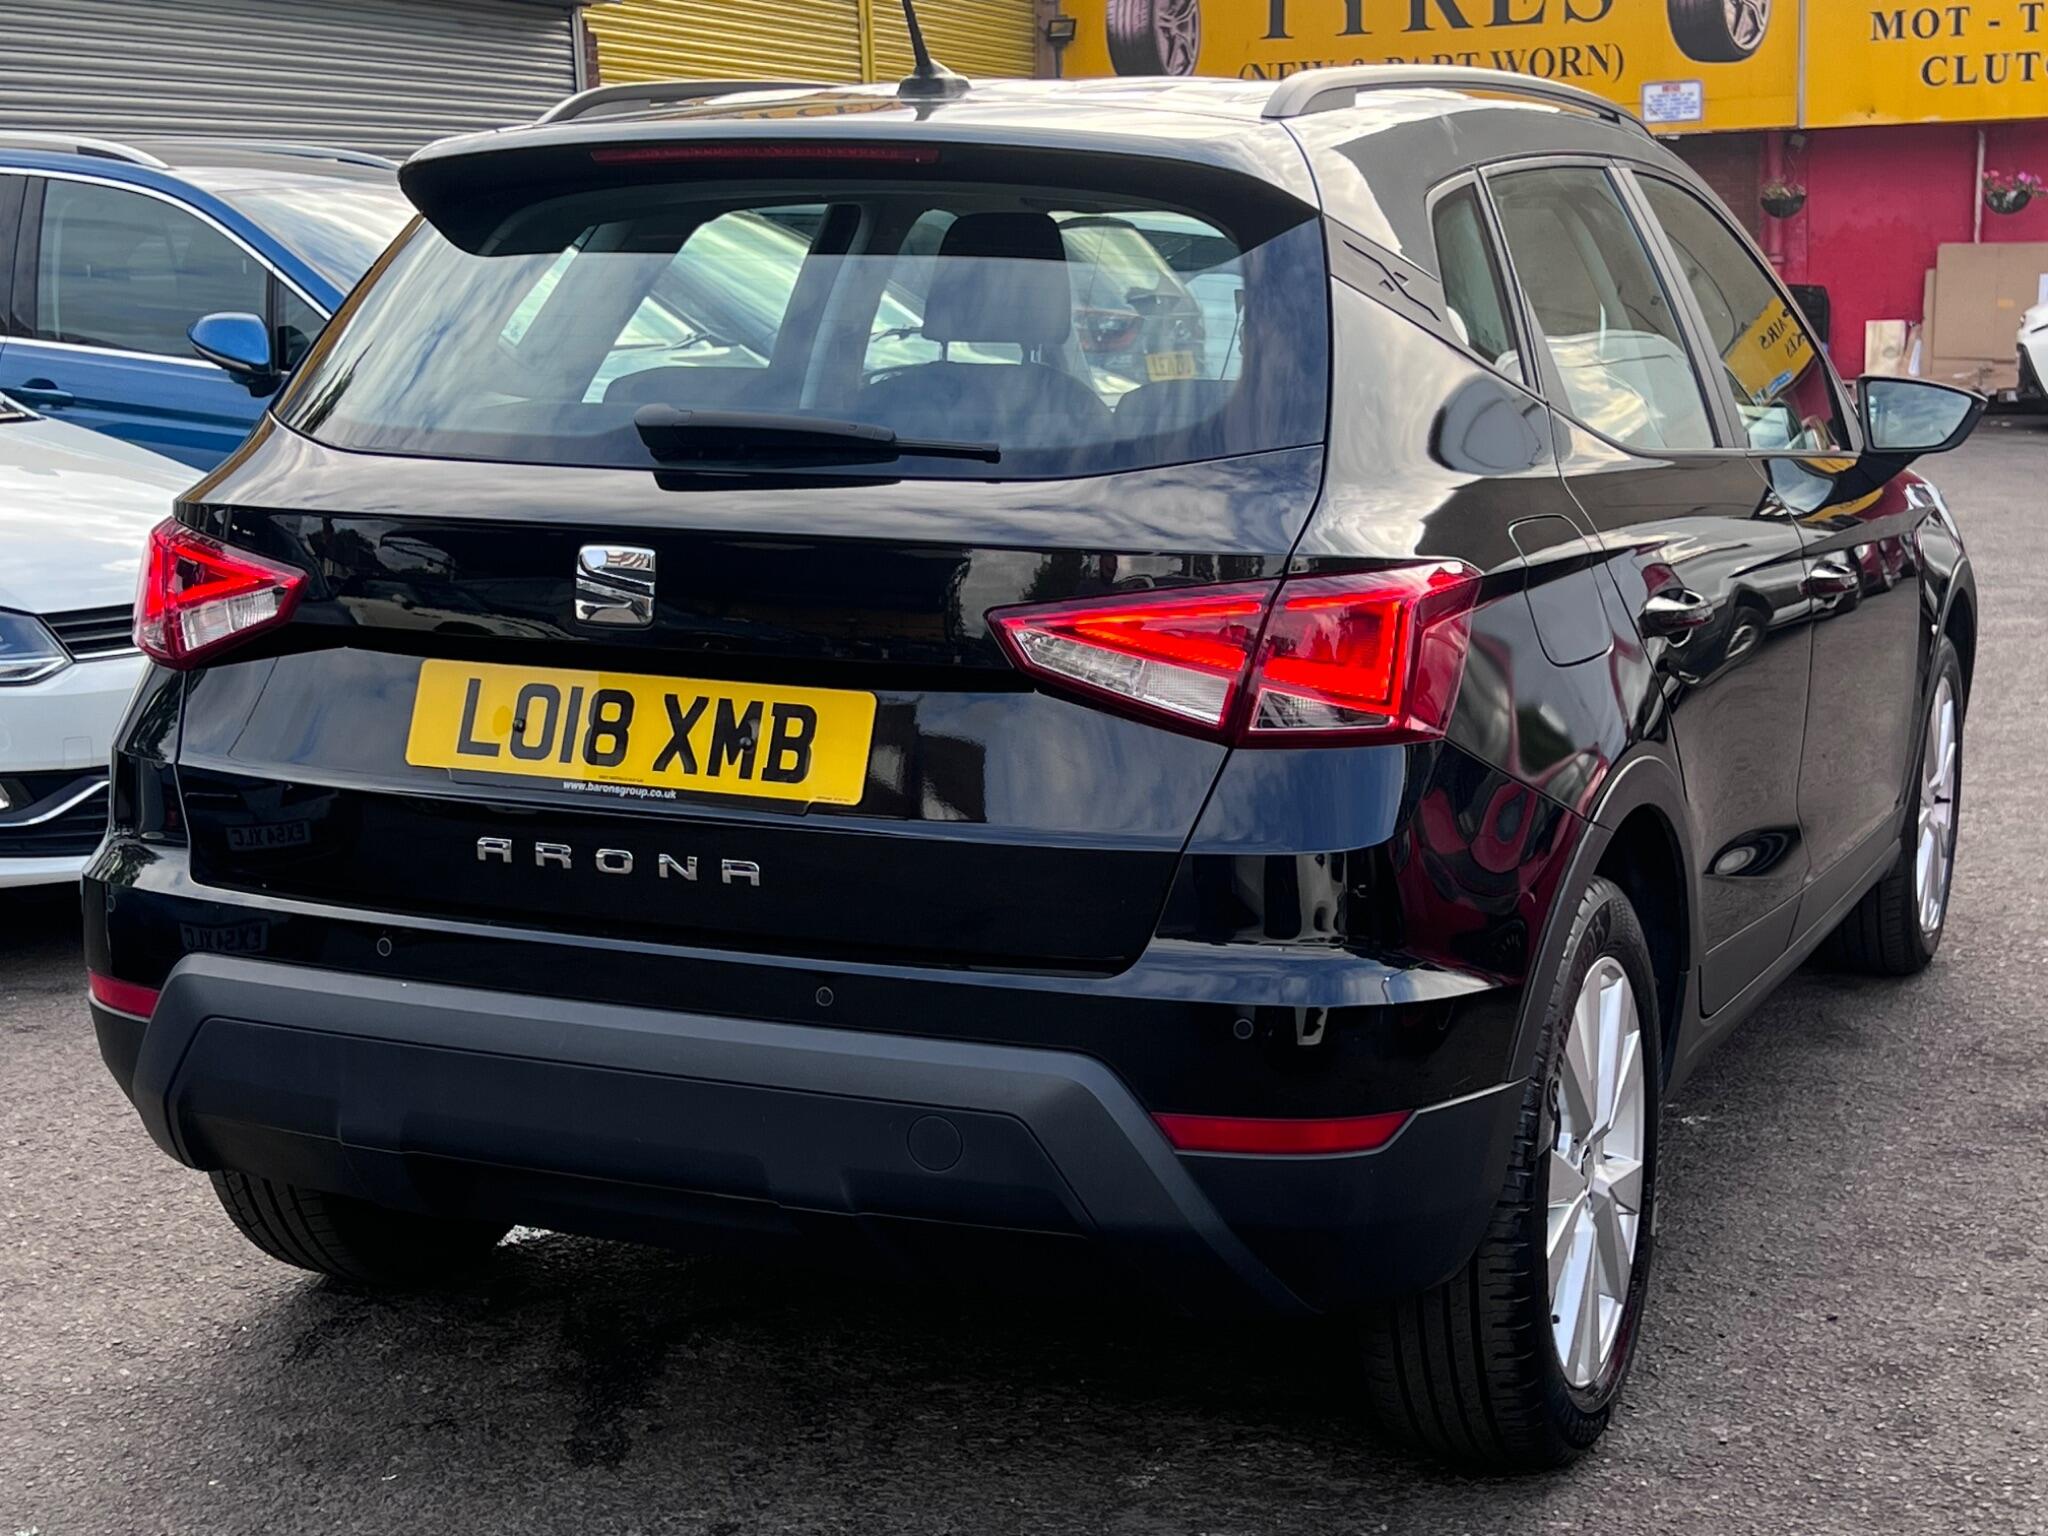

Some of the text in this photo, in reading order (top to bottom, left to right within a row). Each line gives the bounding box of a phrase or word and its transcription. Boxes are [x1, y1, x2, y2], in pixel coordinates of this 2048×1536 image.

[1870, 6, 1971, 41] MOT
[1490, 43, 1624, 83] WORN)
[1920, 51, 2048, 87] CLUT
[456, 678, 818, 784] LO18 XMB
[562, 780, 677, 799] www.baronsgroup.co.uk
[476, 836, 760, 887] ARONA
